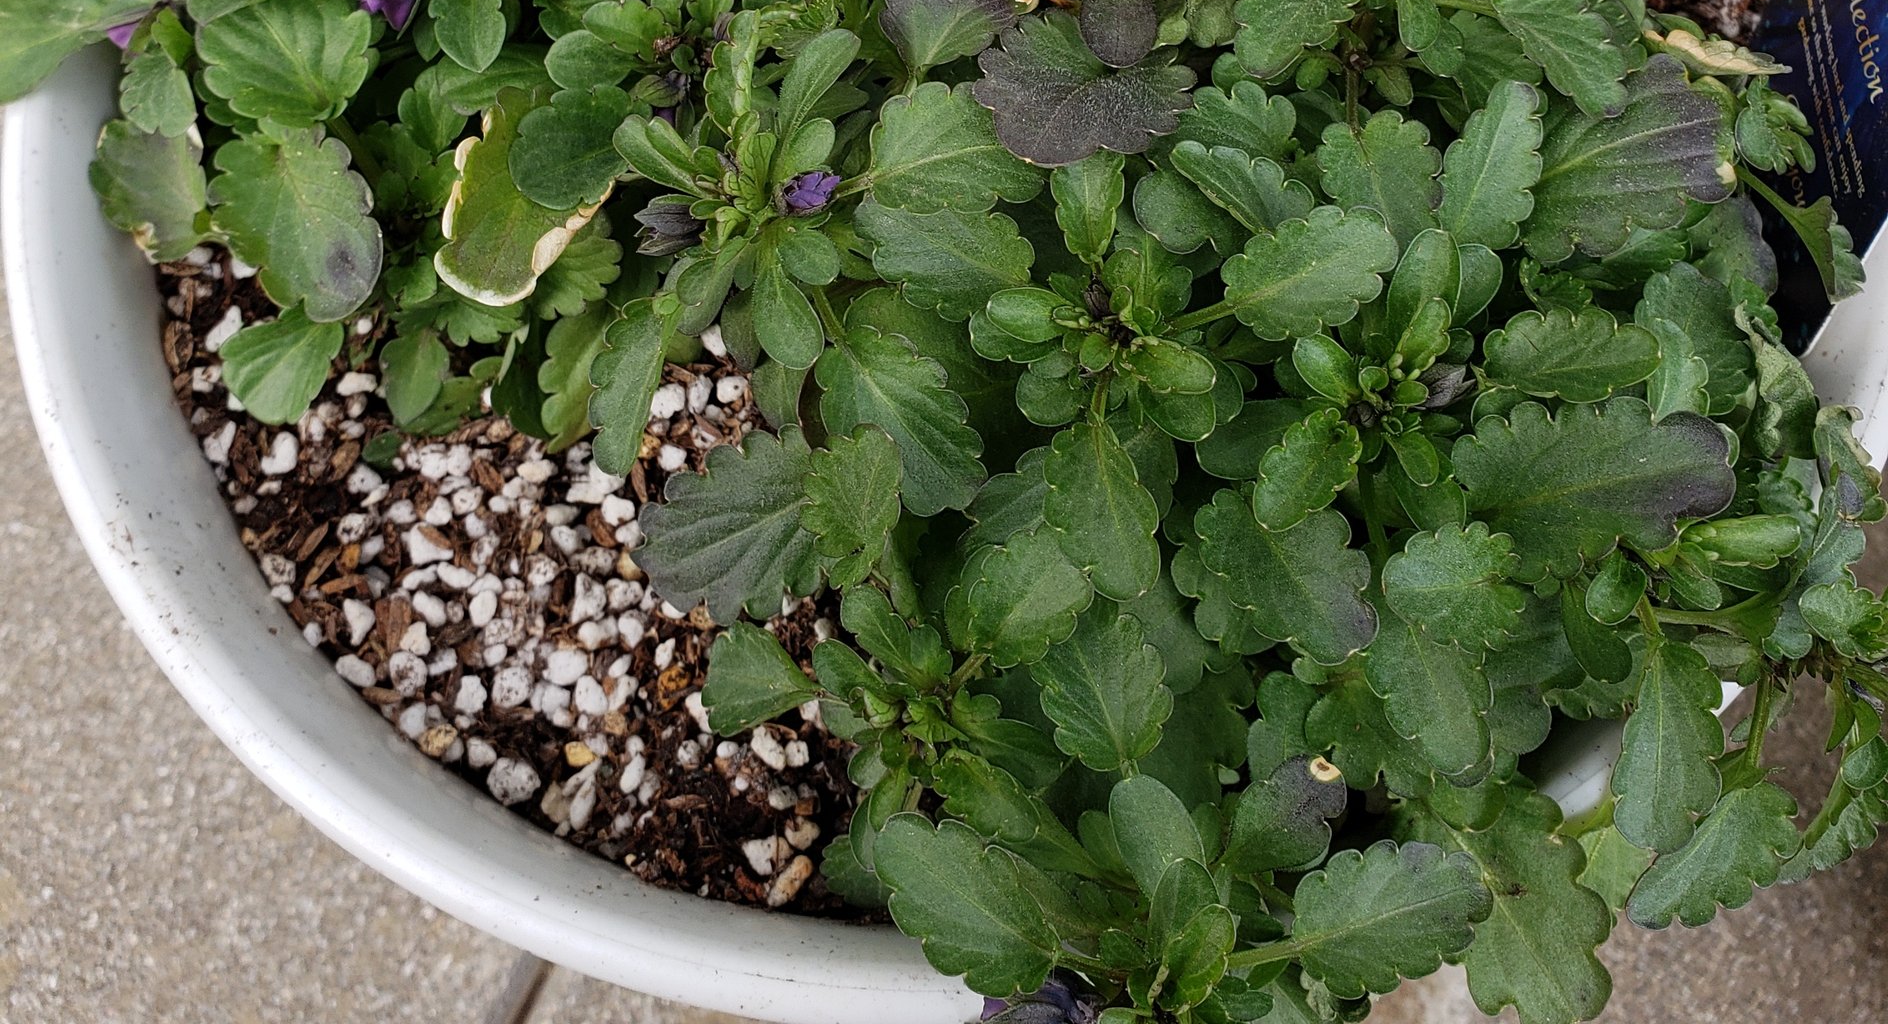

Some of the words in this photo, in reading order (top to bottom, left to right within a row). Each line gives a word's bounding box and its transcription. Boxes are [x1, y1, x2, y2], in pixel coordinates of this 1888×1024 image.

[1797, 16, 1815, 87] gardening
[1812, 83, 1823, 115] with
[1813, 32, 1823, 63] that
[1819, 63, 1836, 124] everyone
[1832, 126, 1842, 152] can
[1839, 154, 1852, 194] enjoy
[1821, 3, 1834, 65] working
[1831, 57, 1844, 96] hard
[1839, 97, 1850, 126] and
[1845, 127, 1865, 198] spending
